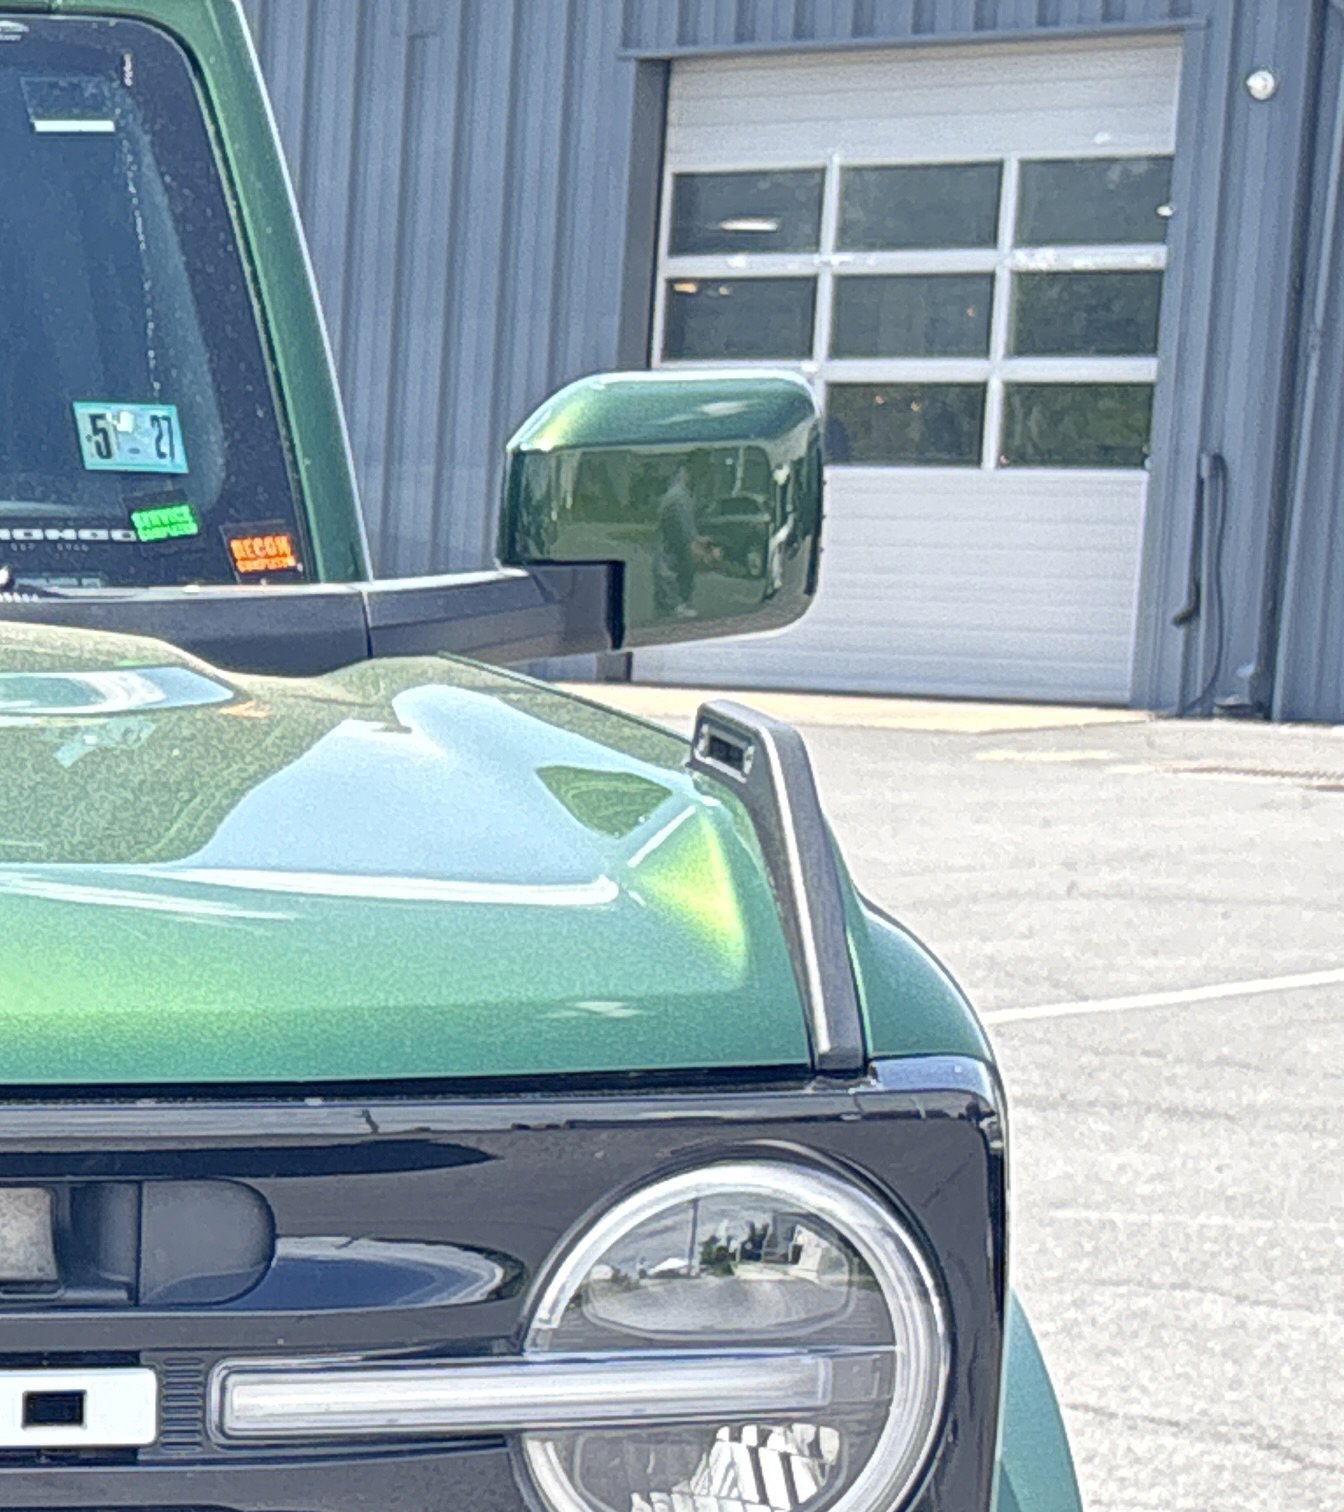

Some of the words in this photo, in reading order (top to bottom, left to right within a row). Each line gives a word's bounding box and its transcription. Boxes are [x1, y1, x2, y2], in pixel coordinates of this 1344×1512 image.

[89, 412, 113, 460] 5
[150, 414, 175, 462] 27
[230, 535, 293, 563] RECON
